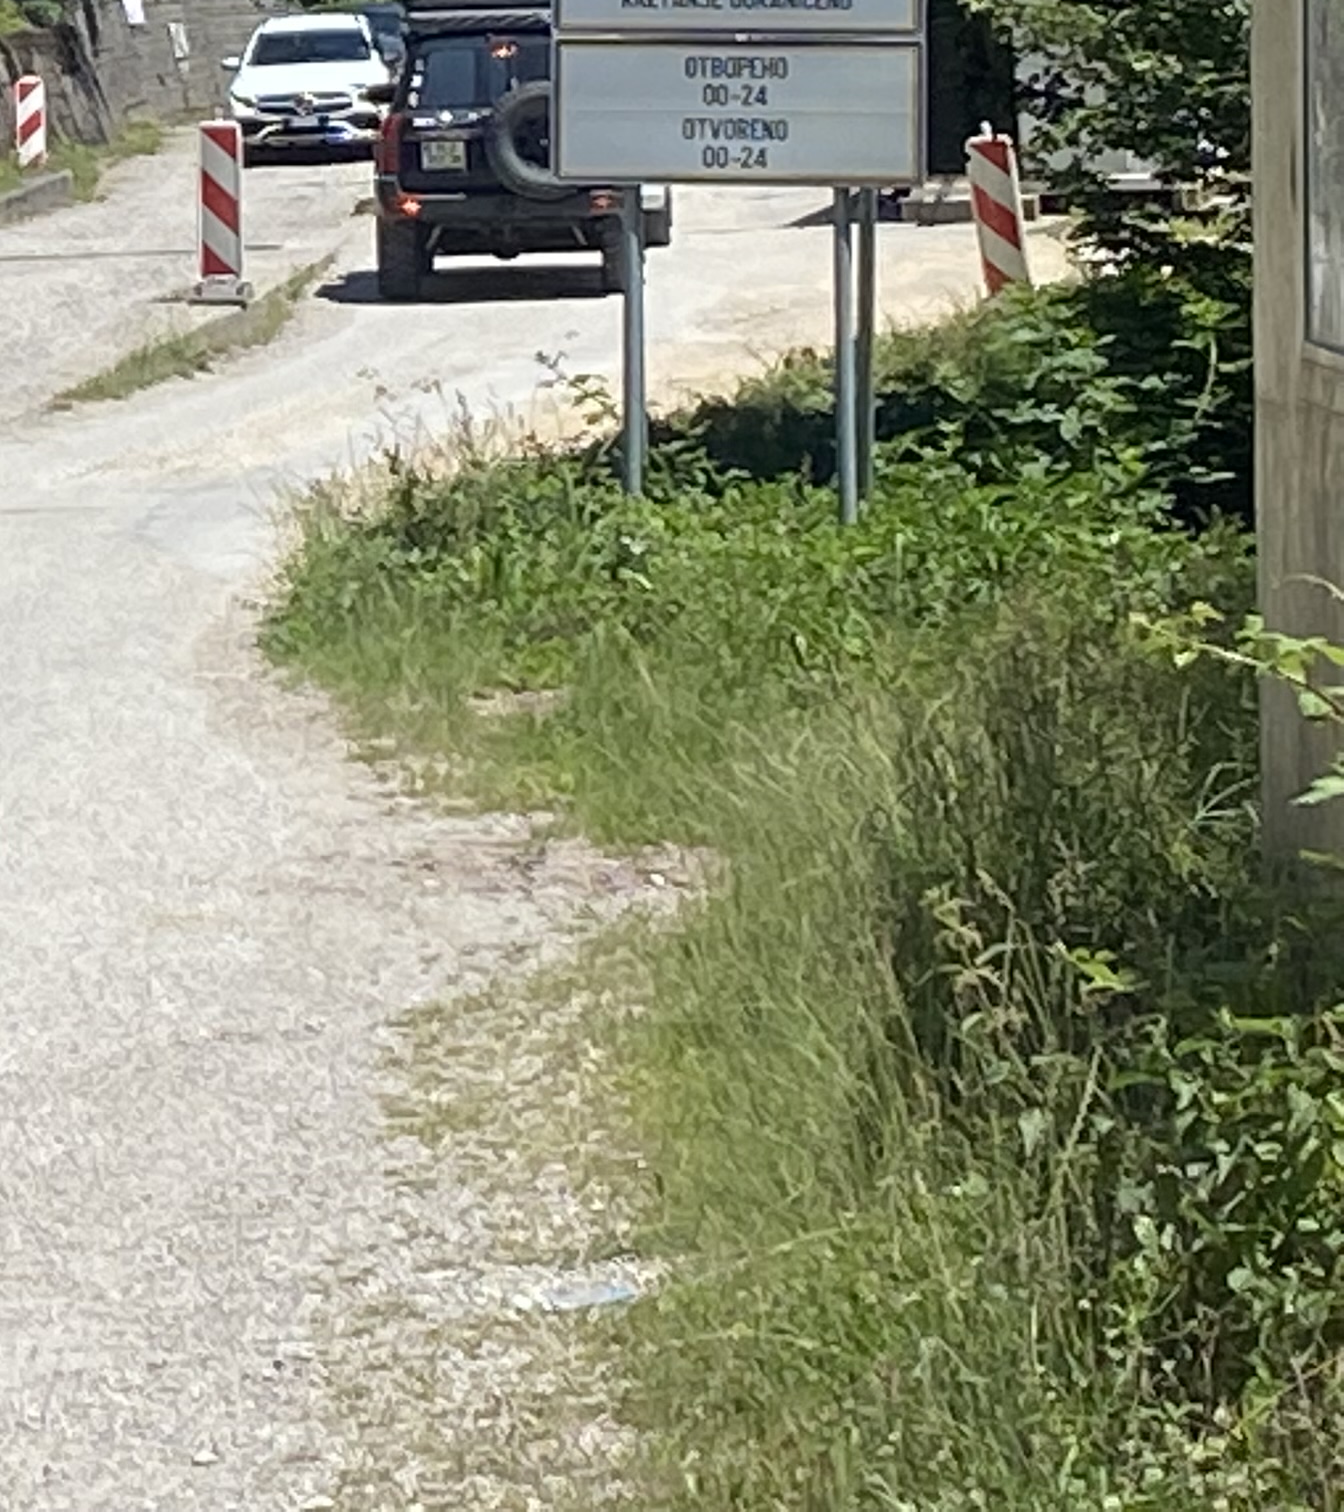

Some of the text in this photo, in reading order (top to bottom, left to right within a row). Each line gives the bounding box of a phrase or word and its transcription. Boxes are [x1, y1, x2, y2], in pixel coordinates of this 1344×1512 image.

[685, 57, 788, 79] ОТВОРЕНО
[703, 83, 768, 106] 00-24
[682, 118, 788, 142] OTVORENO
[703, 145, 768, 169] 00-24
